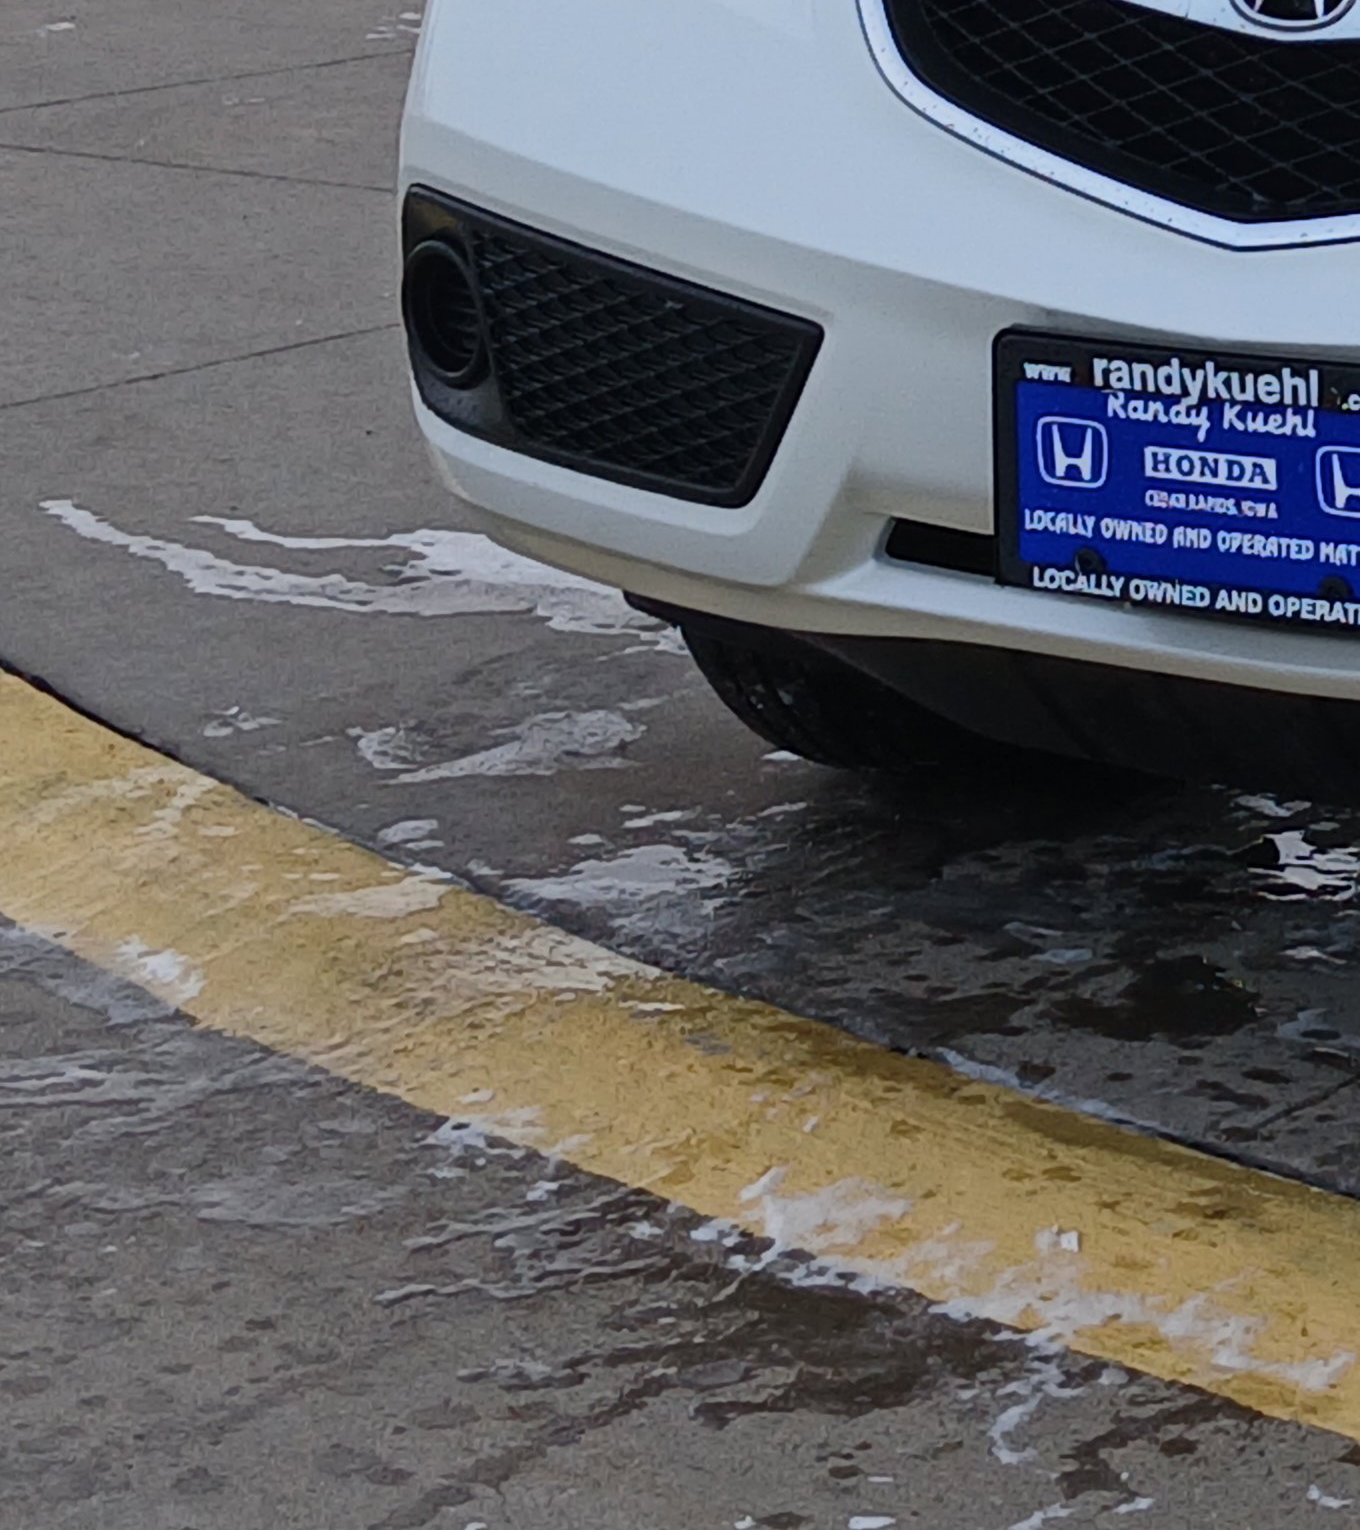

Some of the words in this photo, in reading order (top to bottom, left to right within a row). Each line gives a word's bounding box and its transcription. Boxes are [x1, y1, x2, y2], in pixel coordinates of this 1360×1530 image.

[1093, 357, 1319, 407] randykuehl
[1101, 389, 1211, 442] Randy
[1223, 402, 1317, 438] Kuehl
[1151, 451, 1271, 485] HONDA
[1024, 508, 1096, 539] LOCALLY
[1101, 517, 1168, 545] OWNED
[1173, 526, 1212, 549] AND
[1217, 530, 1315, 560] OPERATED
[1033, 565, 1125, 598] LOCALLY
[1129, 579, 1211, 608] OWNED
[1215, 589, 1263, 614] AND
